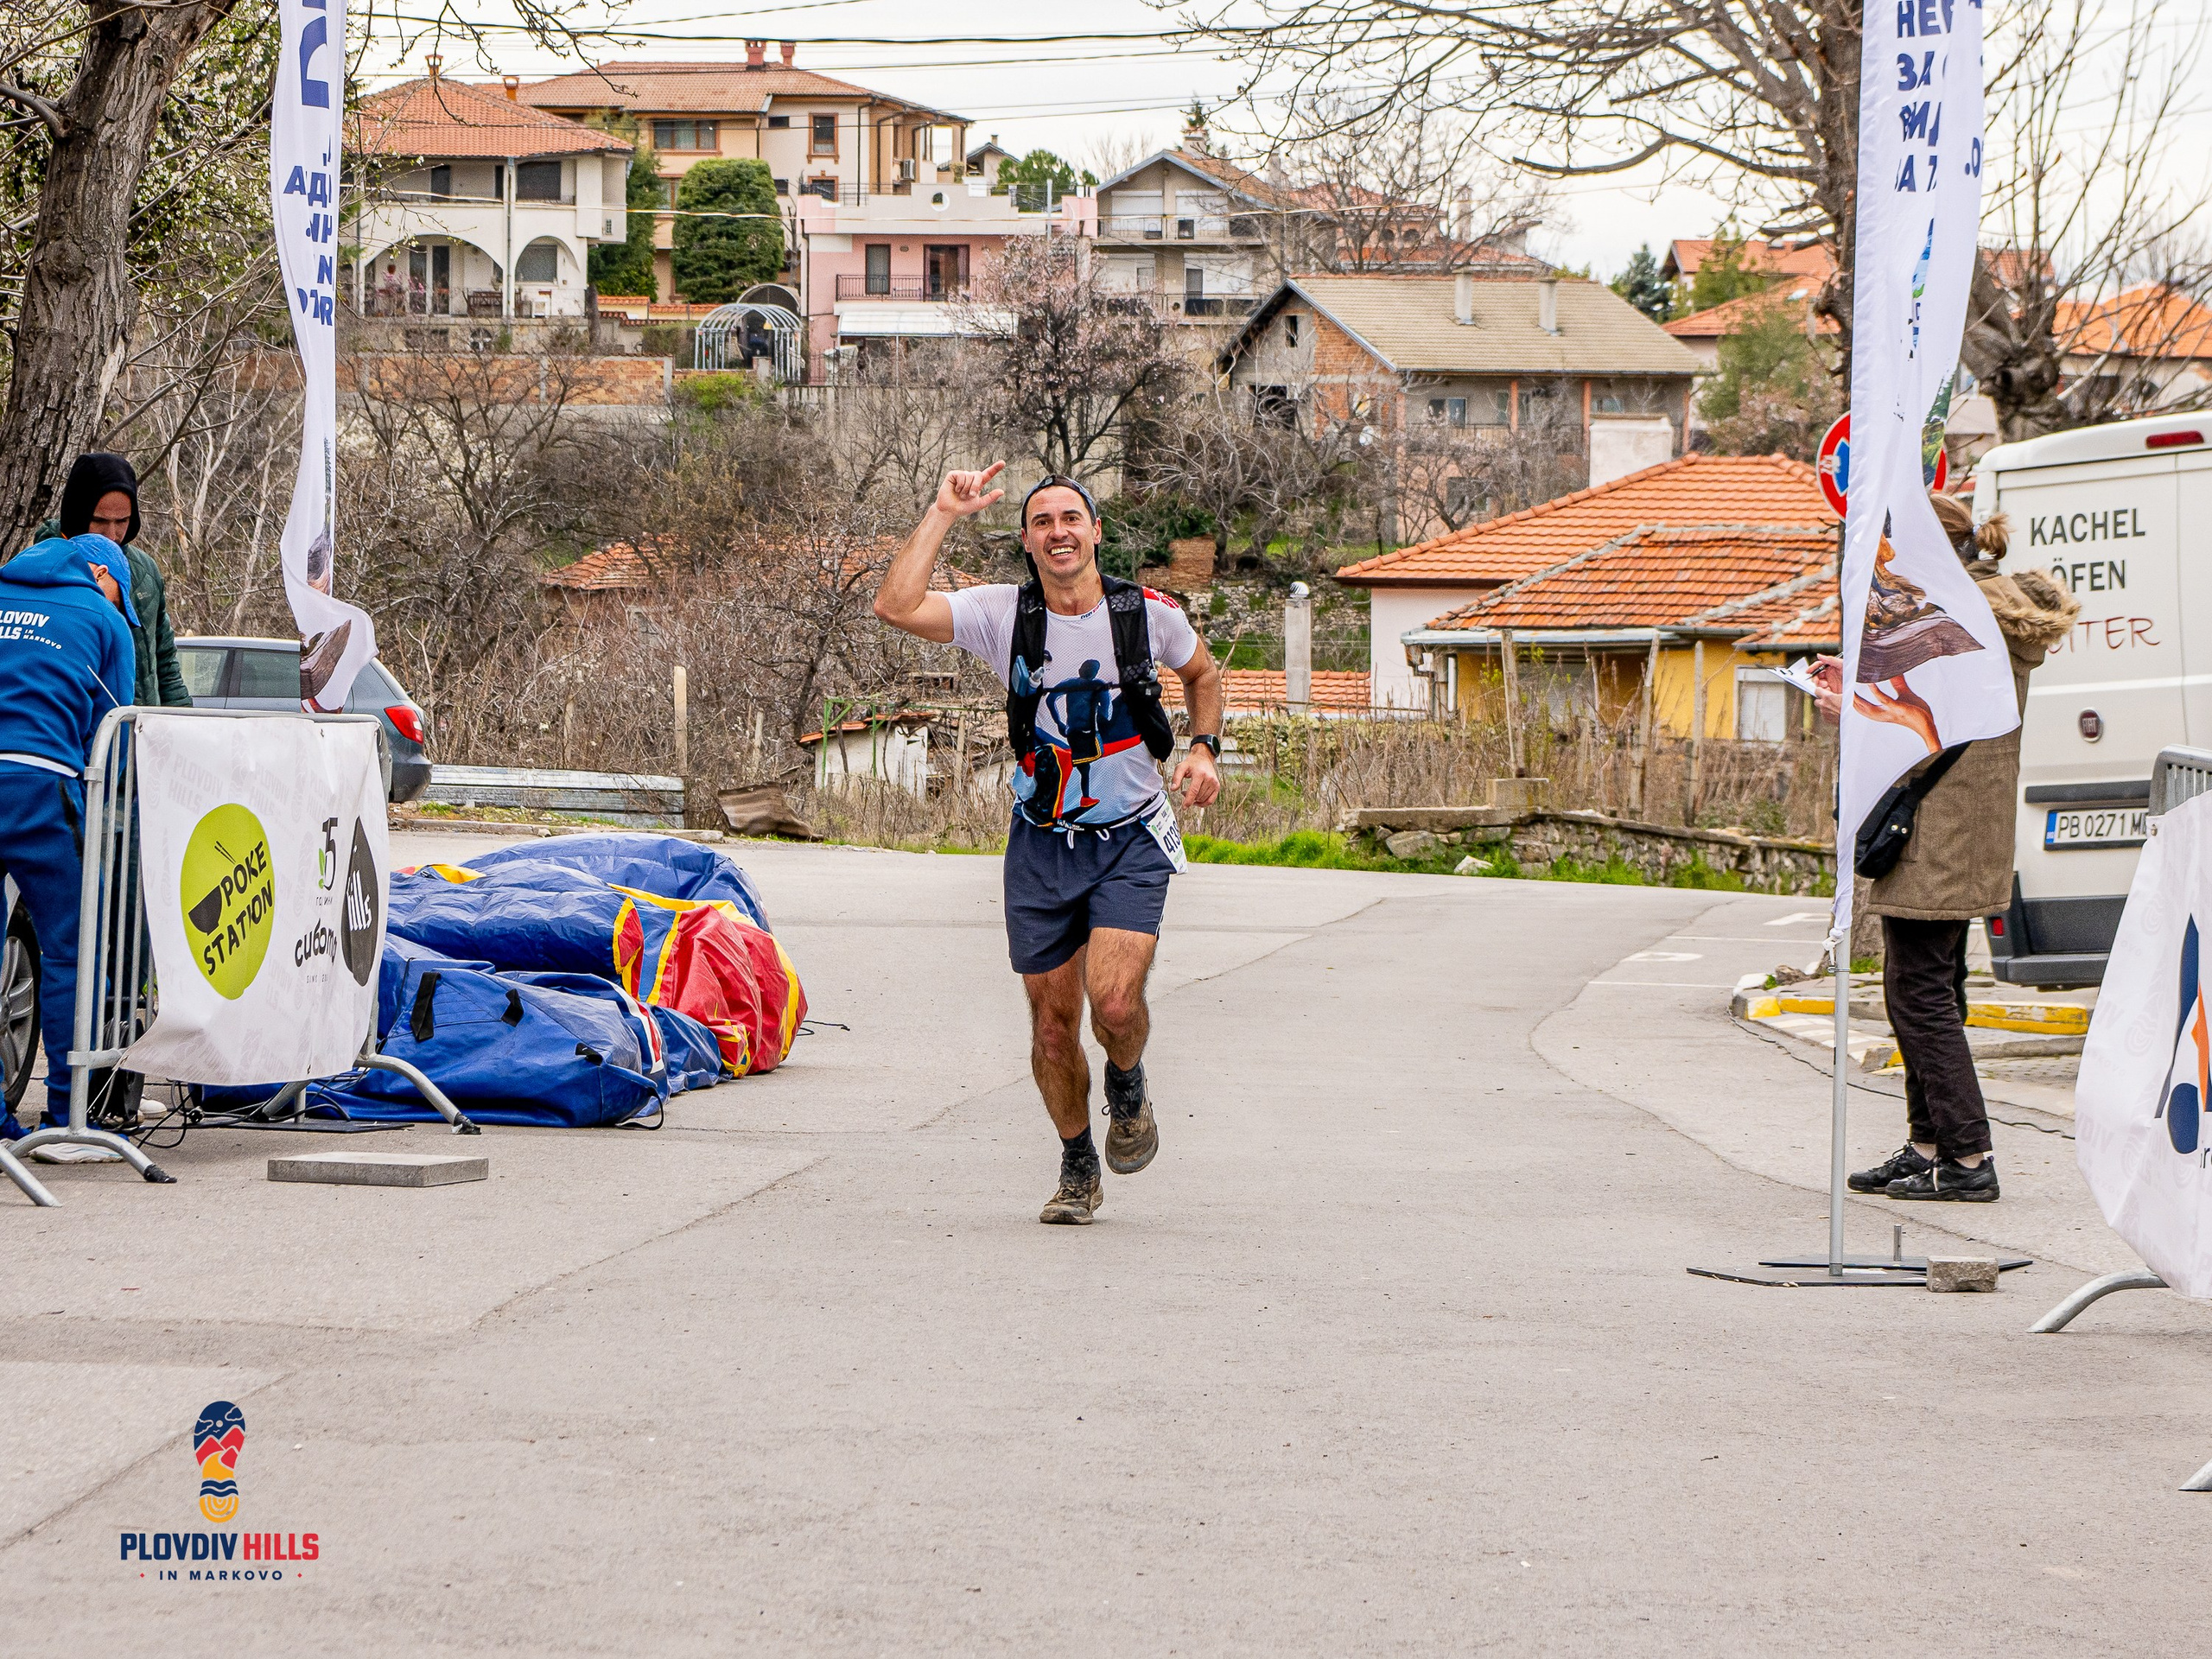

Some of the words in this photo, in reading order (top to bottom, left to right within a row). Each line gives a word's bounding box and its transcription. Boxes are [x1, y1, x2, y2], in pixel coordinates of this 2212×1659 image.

[2030, 508, 2145, 547] KACHEL
[2051, 557, 2126, 593] ÖFEN
[22, 634, 62, 650] MARKOVO
[2058, 816, 2080, 838] PB
[2085, 813, 2125, 837] 0271
[220, 841, 267, 907] POKE
[203, 880, 273, 976] STATION
